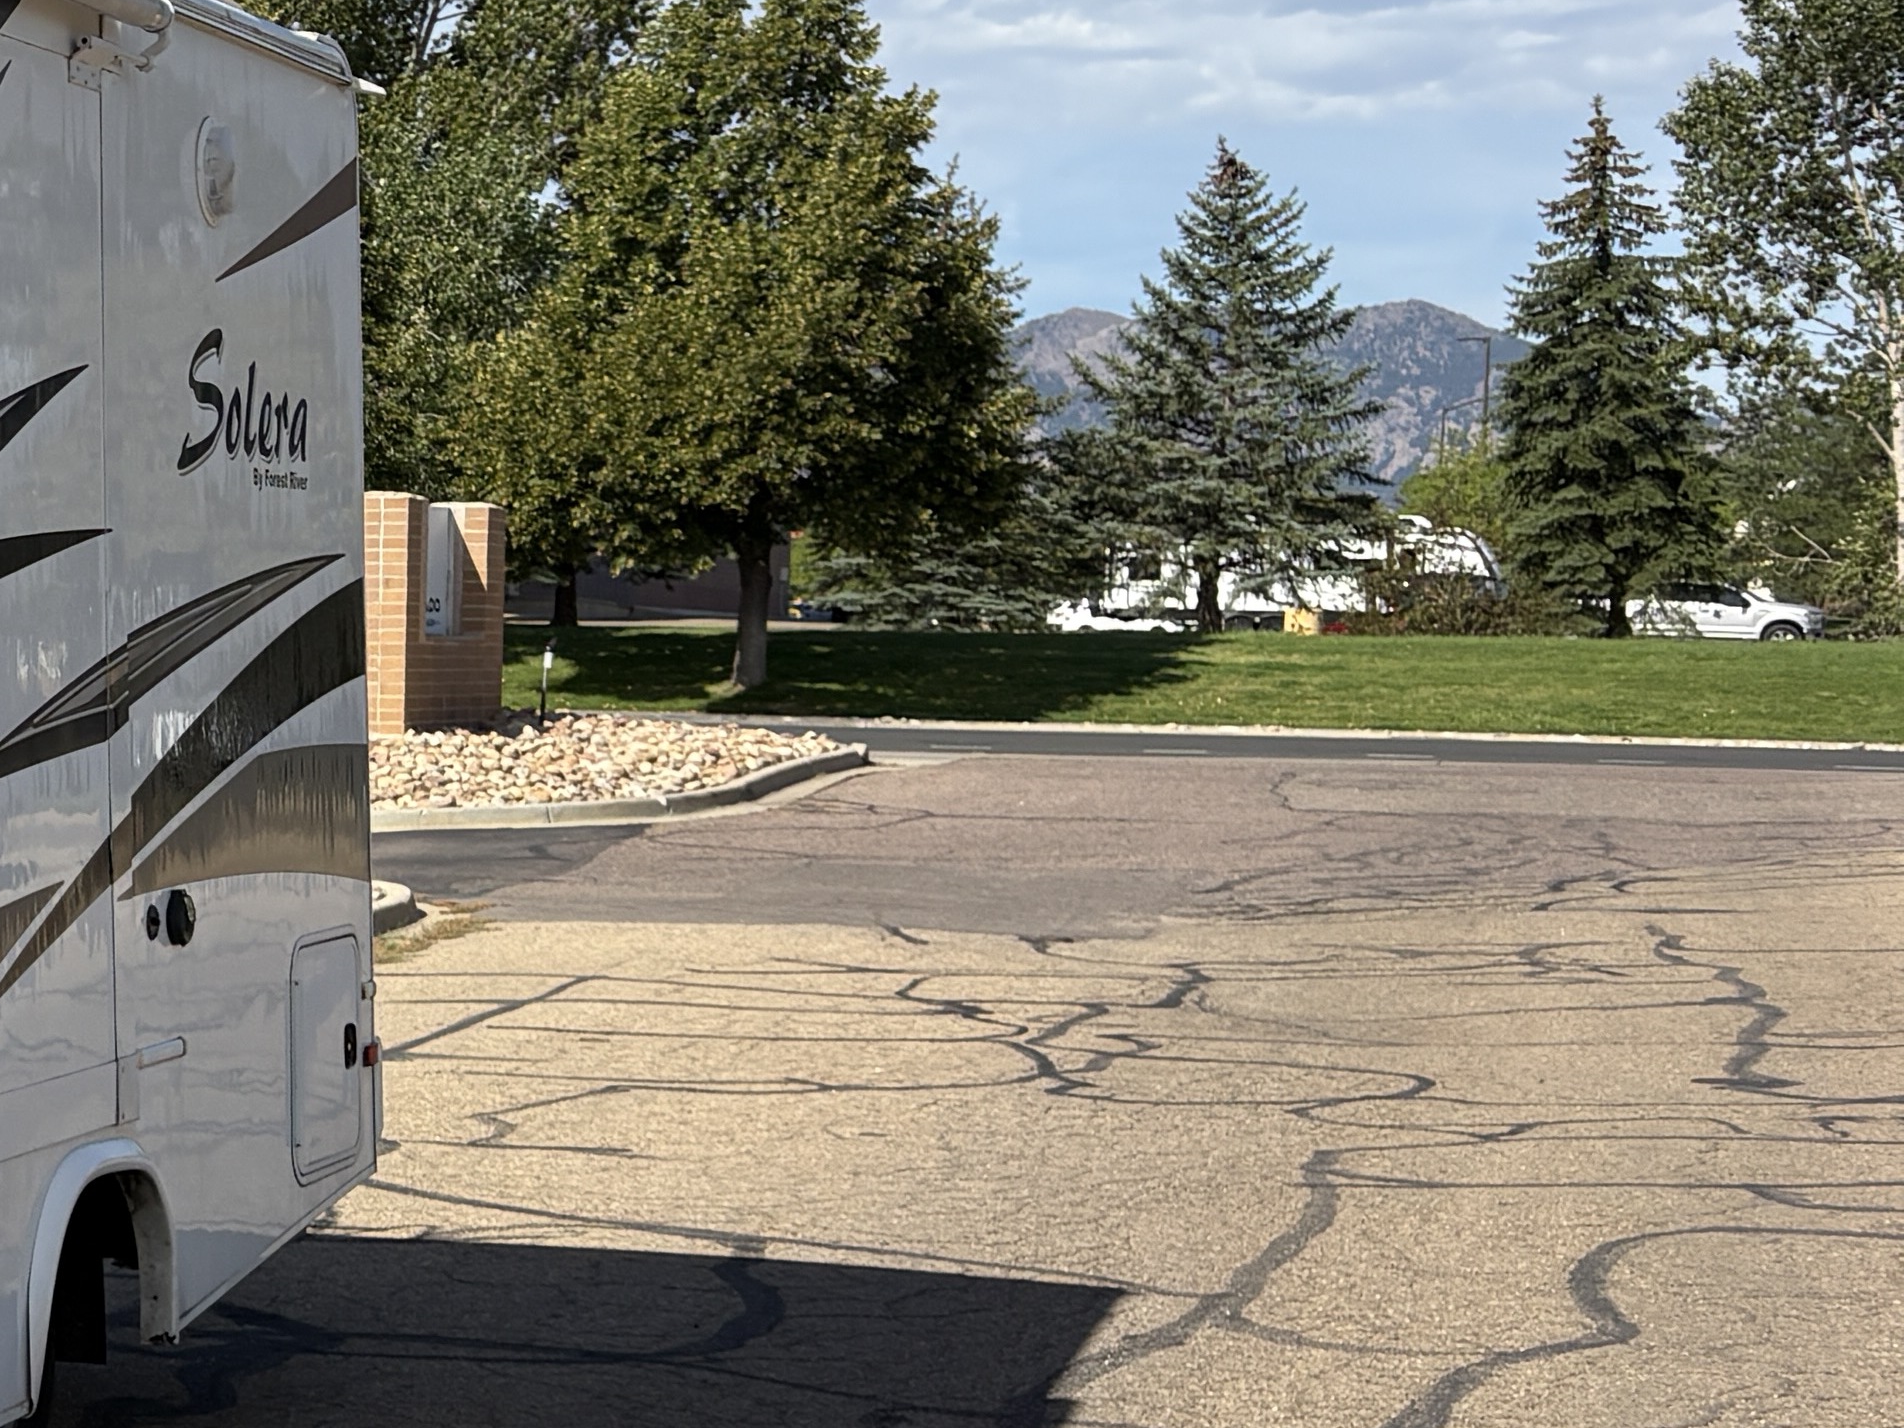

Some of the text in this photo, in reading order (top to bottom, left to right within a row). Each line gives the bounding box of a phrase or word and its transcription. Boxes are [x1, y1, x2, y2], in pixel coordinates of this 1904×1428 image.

[177, 328, 308, 476] Solera
[253, 467, 308, 491] By Forest River
